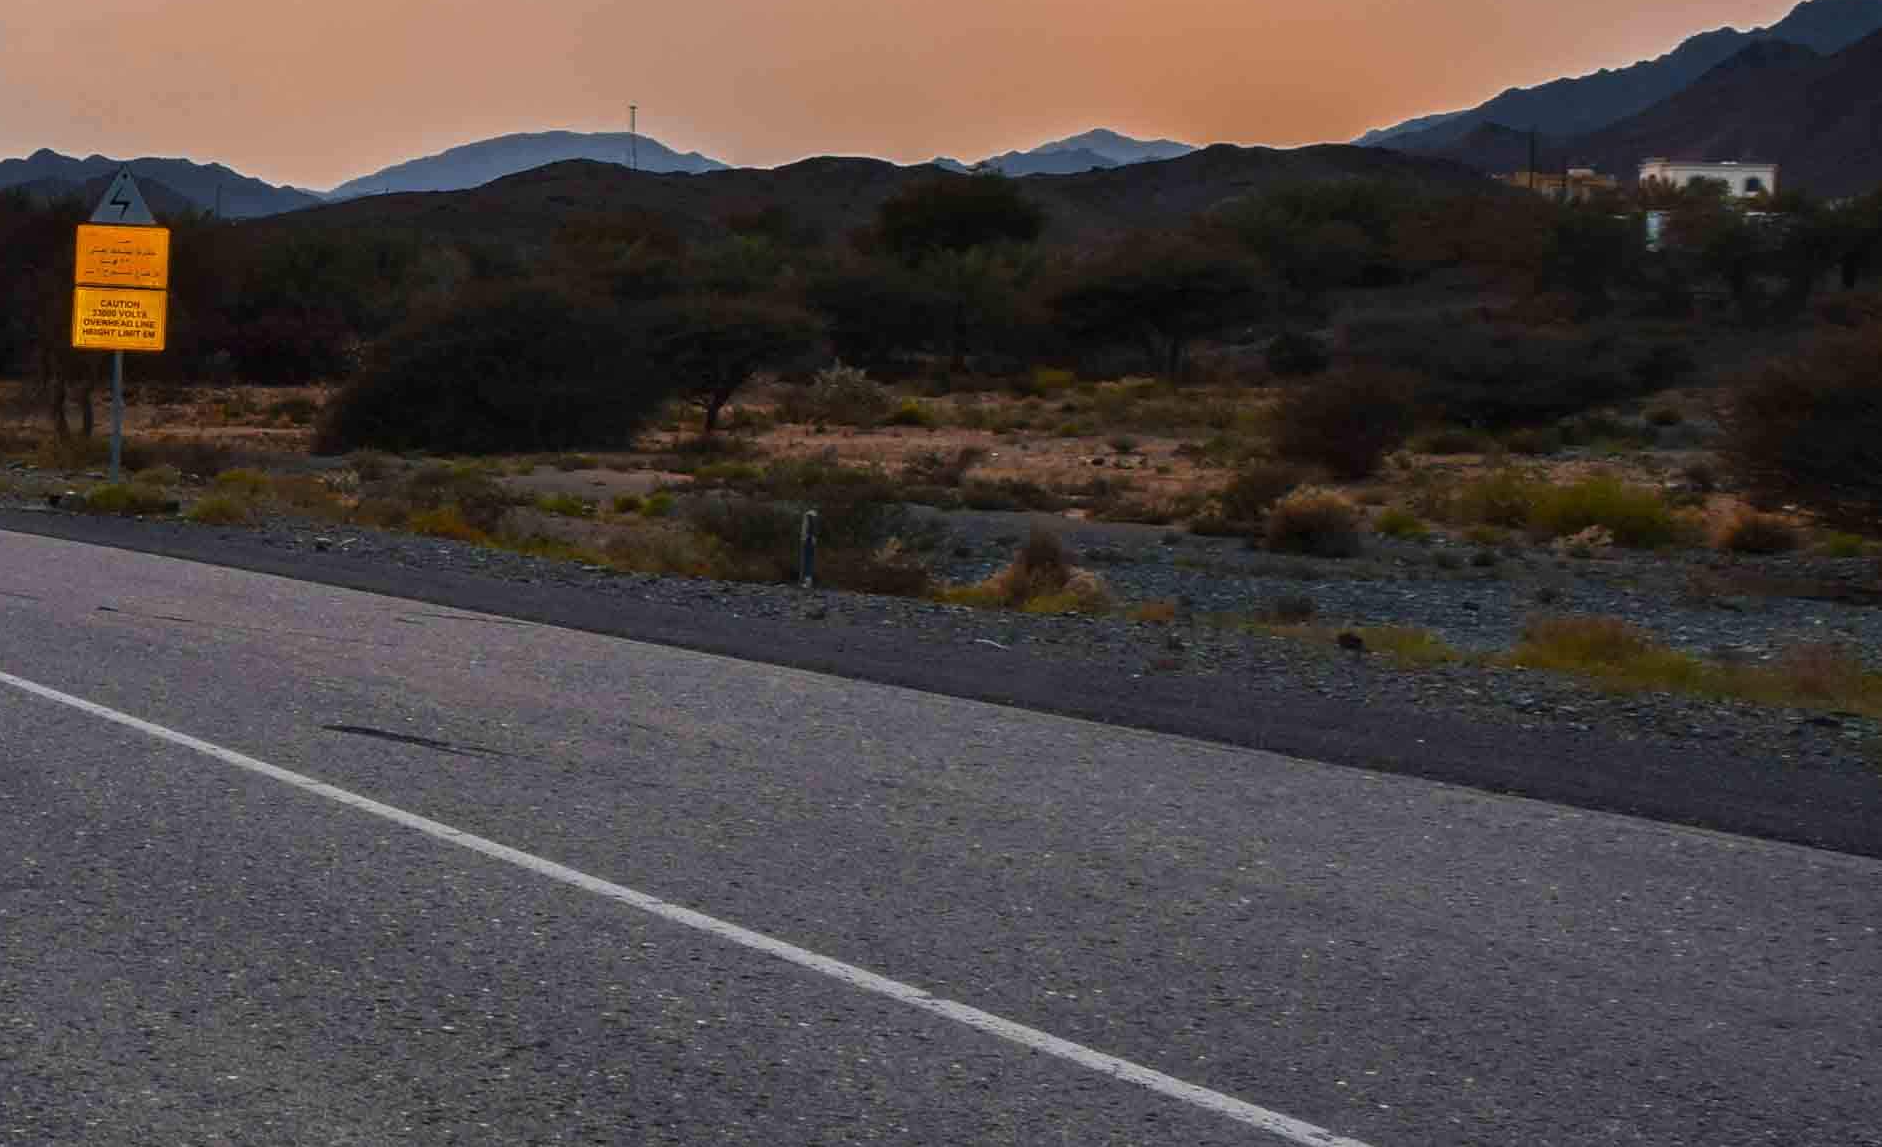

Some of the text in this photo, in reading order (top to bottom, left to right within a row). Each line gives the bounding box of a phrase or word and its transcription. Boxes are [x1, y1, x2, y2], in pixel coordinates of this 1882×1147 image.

[100, 300, 140, 308] CAUTION
[83, 318, 157, 328] OVERHEAD LINE
[83, 328, 116, 336] HEIGHT
[117, 329, 141, 337] LIMIT
